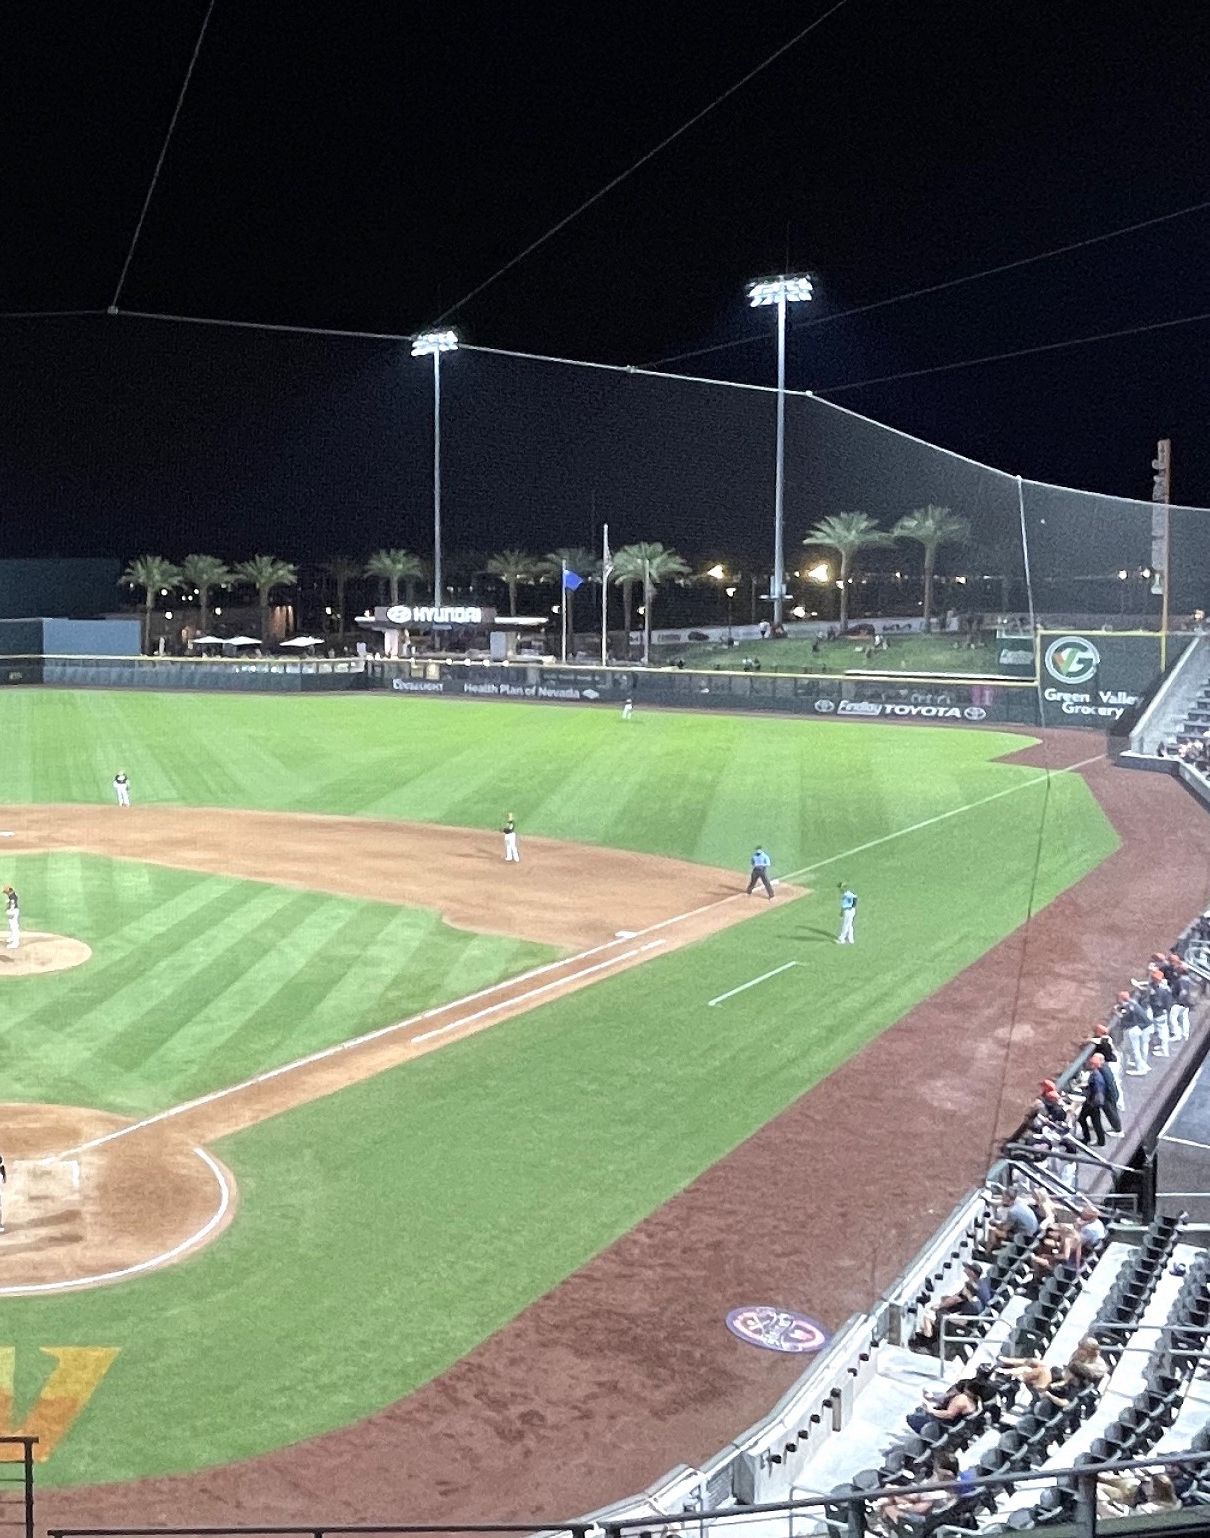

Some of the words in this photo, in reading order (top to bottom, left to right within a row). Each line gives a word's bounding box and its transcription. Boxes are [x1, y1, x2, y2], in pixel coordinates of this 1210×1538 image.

[413, 606, 482, 622] HYUNDAI
[464, 683, 496, 694] Health
[499, 684, 524, 696] Plan
[525, 686, 538, 696] of
[539, 687, 580, 698] Nevada
[1044, 688, 1090, 702] Green
[883, 704, 961, 718] TOYOTA
[1062, 701, 1124, 720] Grocery
